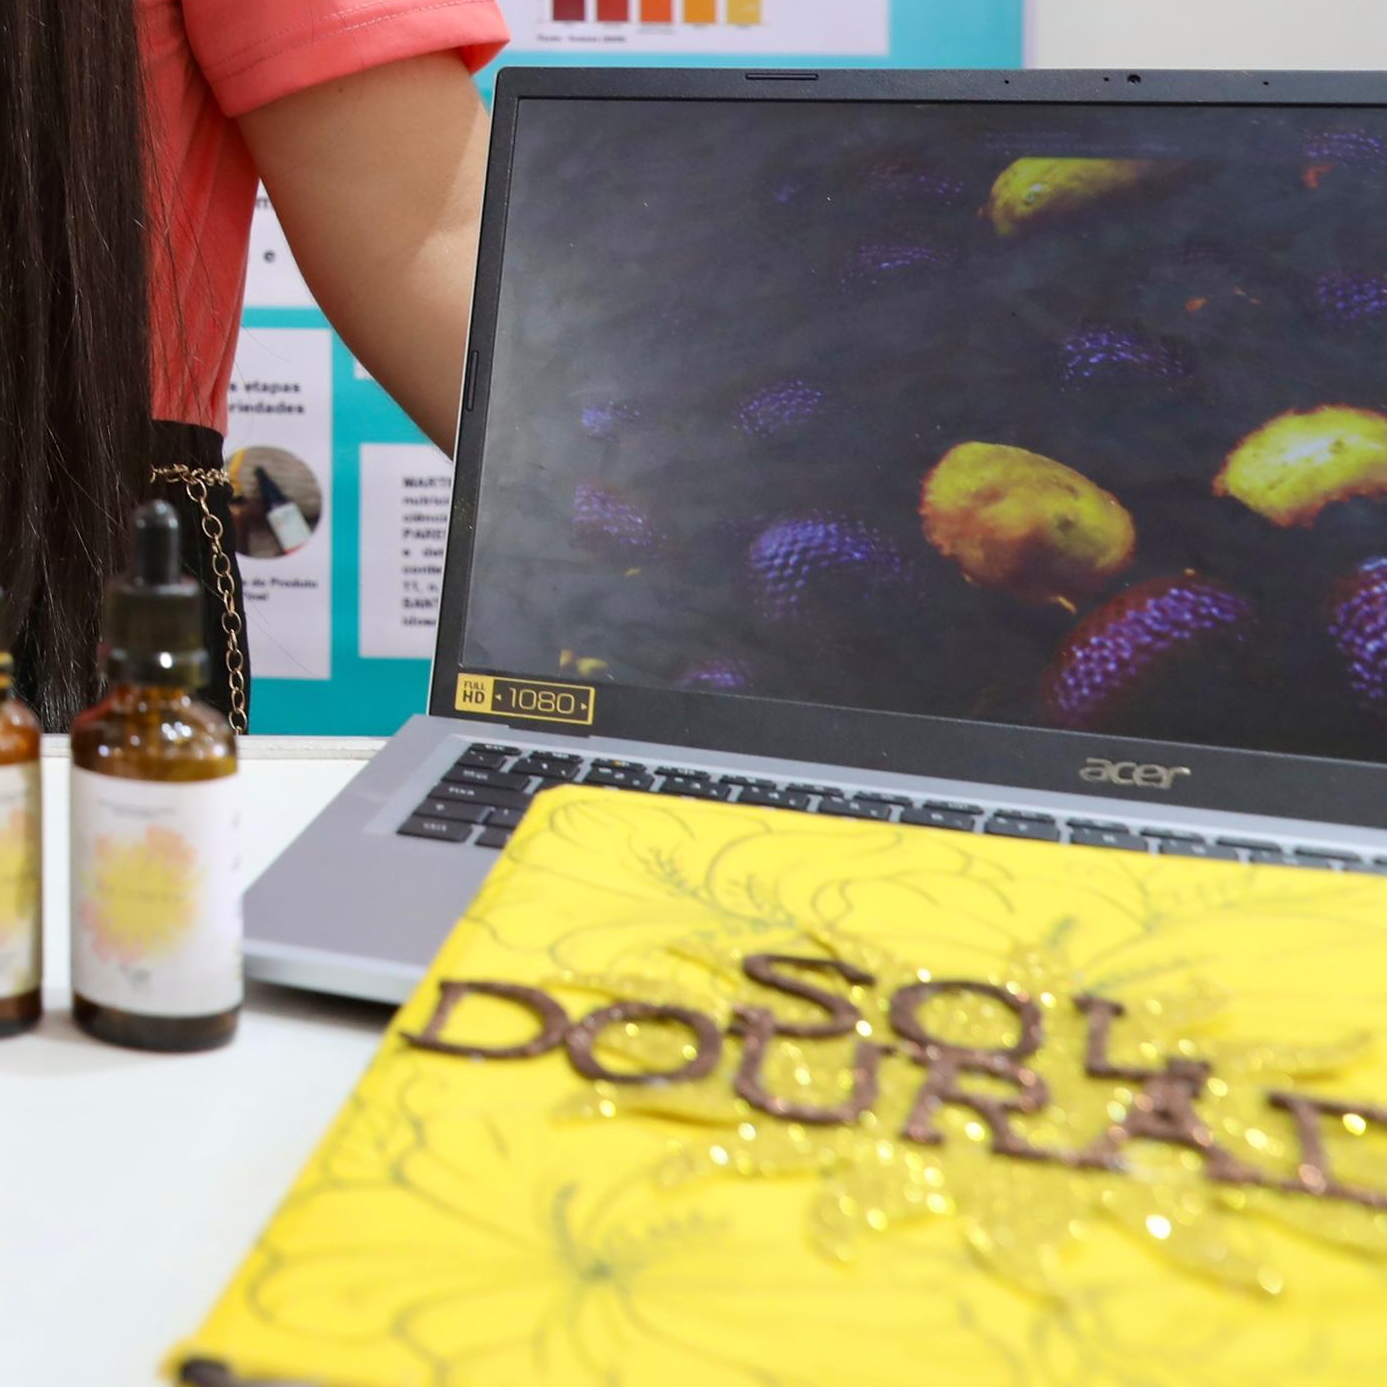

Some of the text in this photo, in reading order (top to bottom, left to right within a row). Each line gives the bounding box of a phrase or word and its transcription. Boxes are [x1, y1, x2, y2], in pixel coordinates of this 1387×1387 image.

[463, 680, 485, 691] FULL
[462, 687, 575, 715] HD 1080
[1079, 757, 1191, 790] acer
[741, 952, 1211, 1084] SOL
